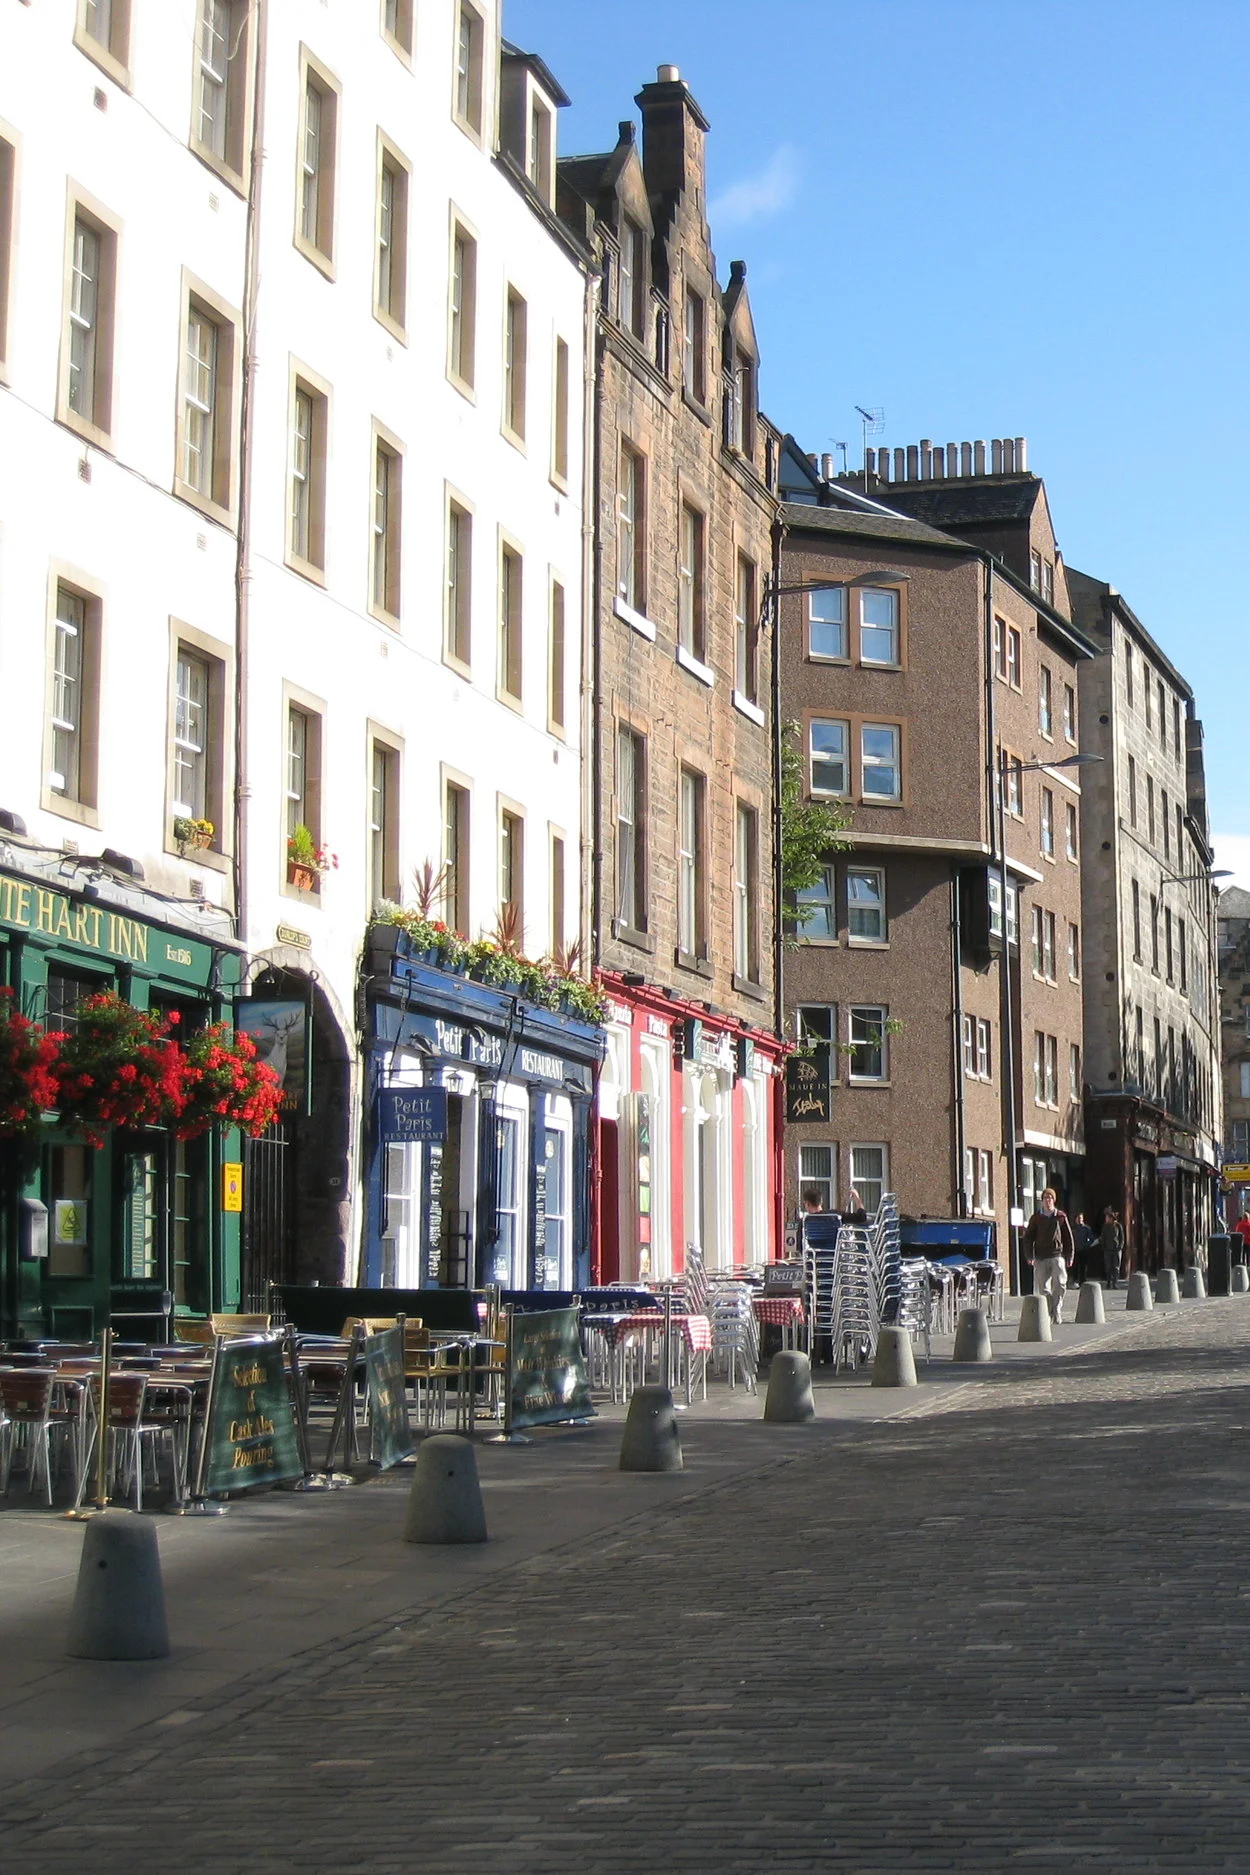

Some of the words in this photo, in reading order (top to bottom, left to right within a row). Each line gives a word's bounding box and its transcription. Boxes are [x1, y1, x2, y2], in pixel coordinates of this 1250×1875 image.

[36, 888, 104, 948] HART
[108, 913, 149, 962] INN
[435, 1019, 463, 1056] Petit
[522, 1049, 564, 1081] RESTAURANT
[789, 1083, 813, 1091] MADE
[392, 1096, 432, 1114] Petit
[792, 1092, 825, 1117] Italy
[394, 1114, 432, 1132] Paris
[383, 1131, 444, 1141] RESTAURANT
[229, 1418, 253, 1443] Cask
[231, 1444, 274, 1469] Pouring
